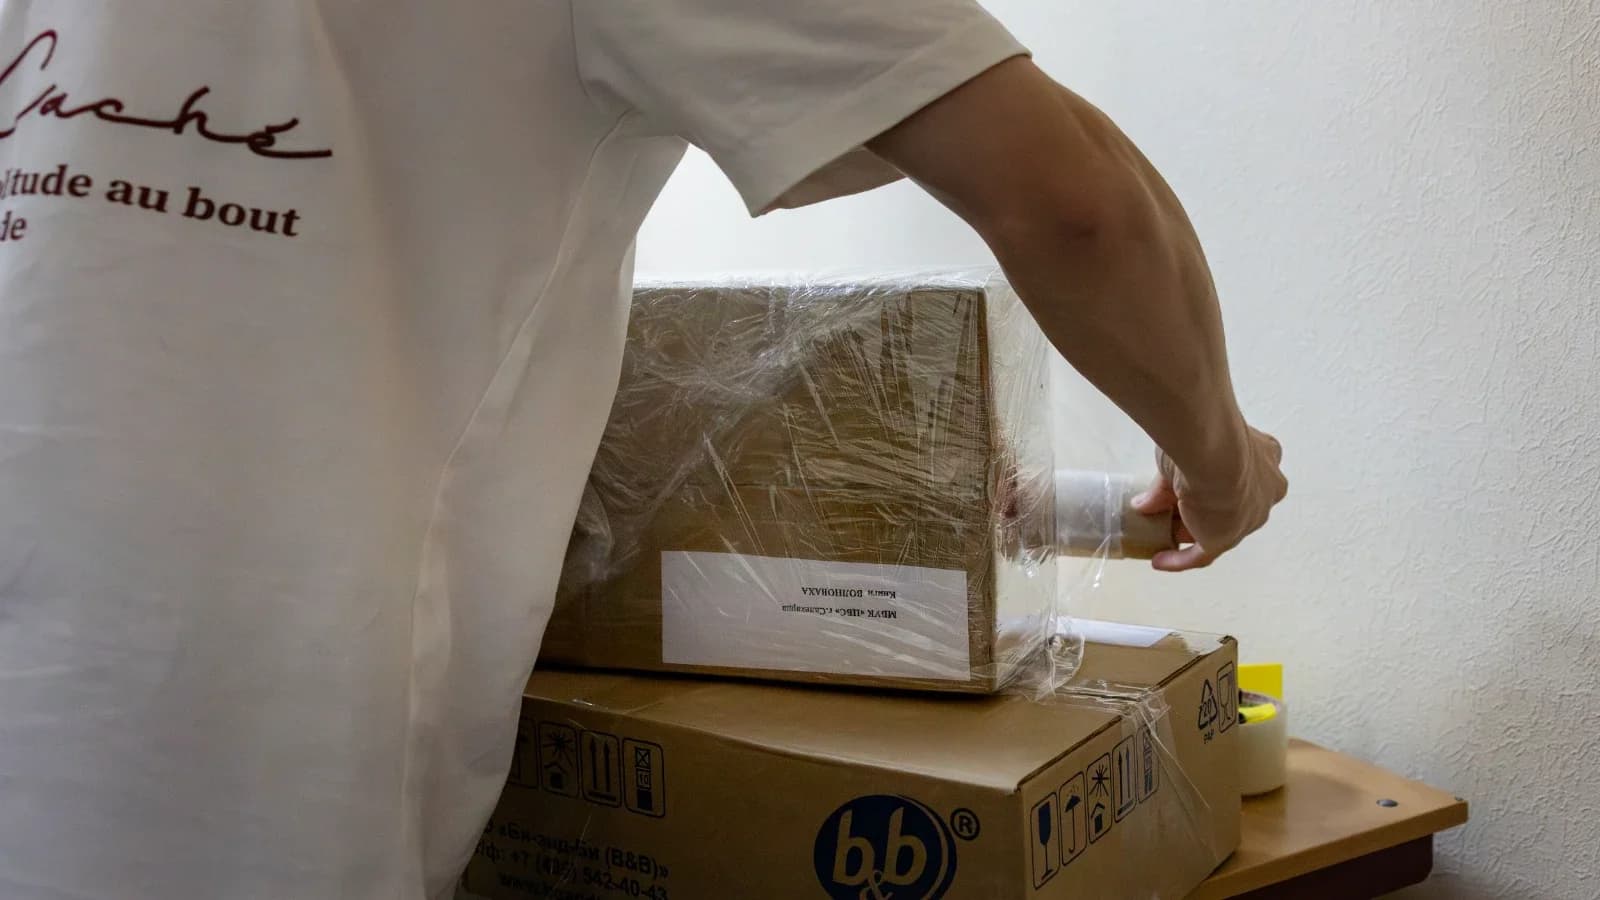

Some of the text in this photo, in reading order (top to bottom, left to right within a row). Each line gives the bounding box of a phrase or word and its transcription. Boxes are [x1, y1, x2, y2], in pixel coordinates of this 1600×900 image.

[105, 178, 171, 213] au
[181, 186, 302, 237] bout
[801, 586, 864, 598] ВОЛНОВАХА
